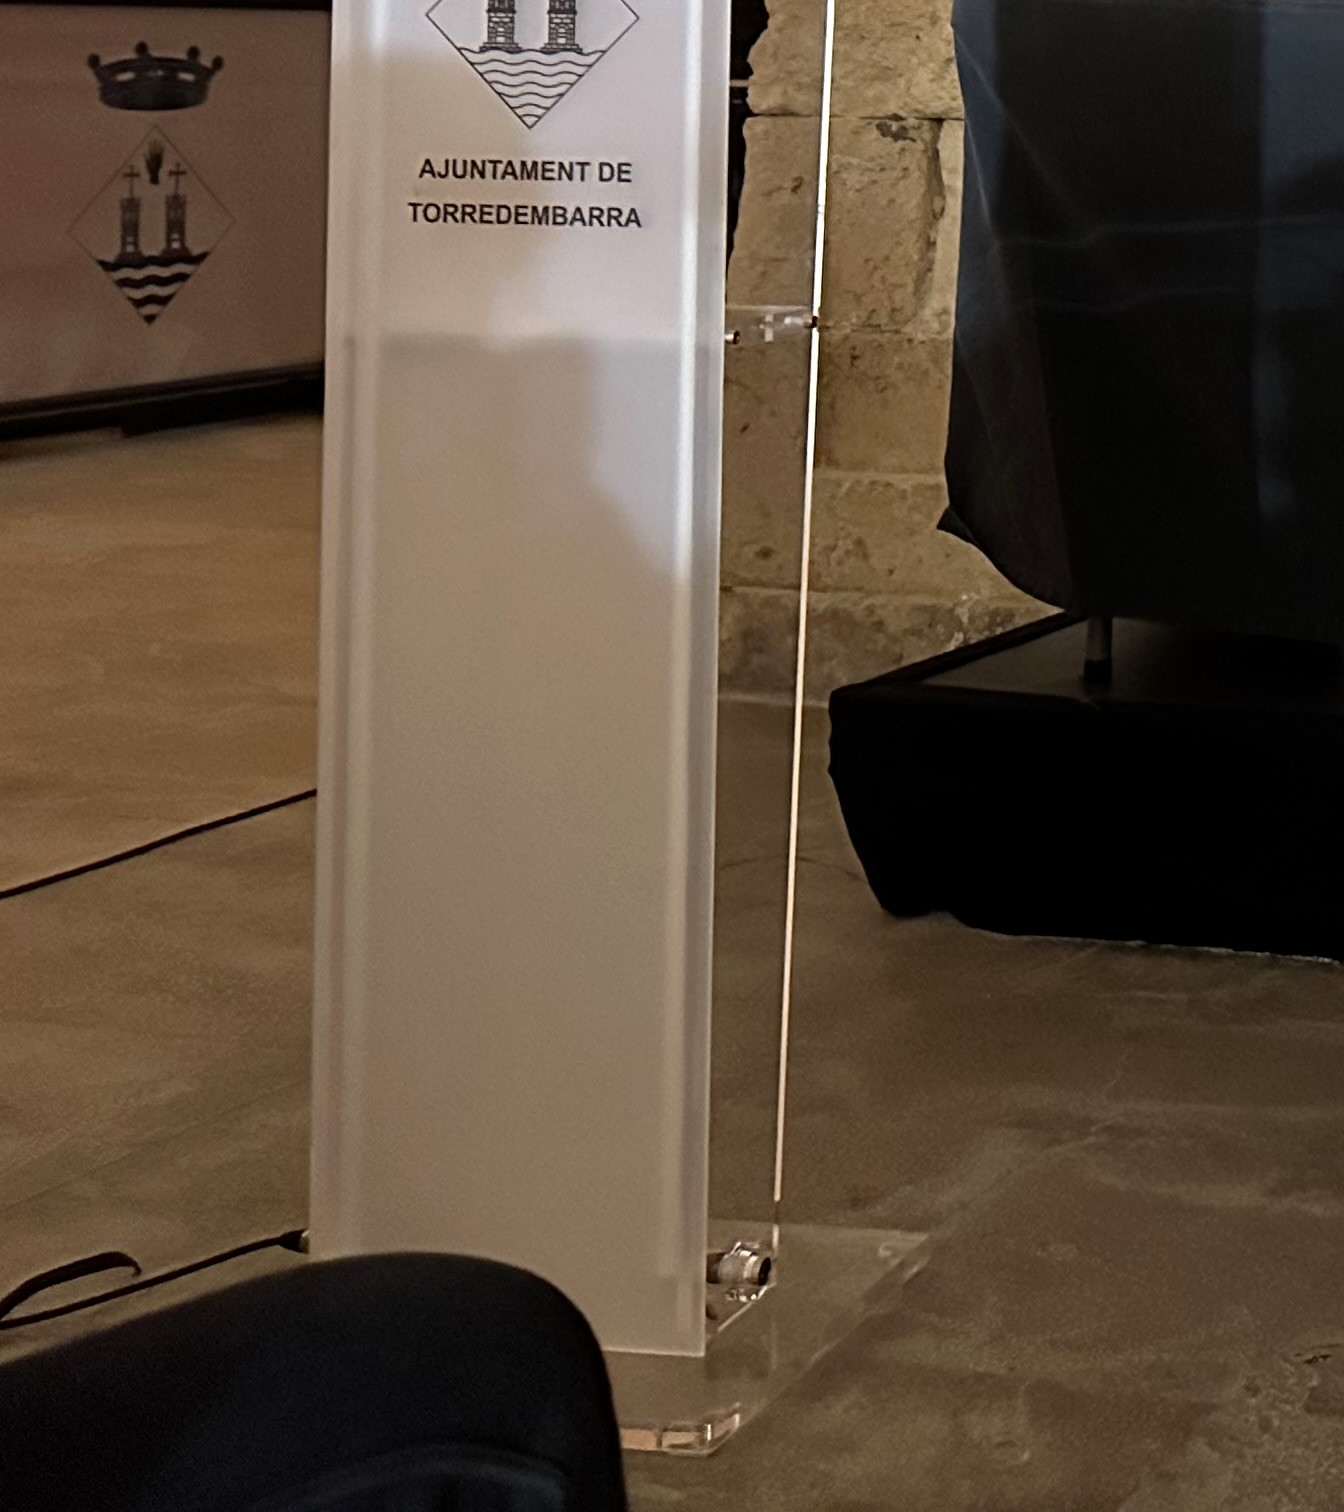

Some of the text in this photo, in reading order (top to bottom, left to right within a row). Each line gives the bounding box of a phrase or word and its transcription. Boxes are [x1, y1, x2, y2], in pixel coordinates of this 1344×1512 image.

[419, 159, 632, 183] AJUNTAMENT DE
[408, 202, 642, 228] TORREDEMBARRA
